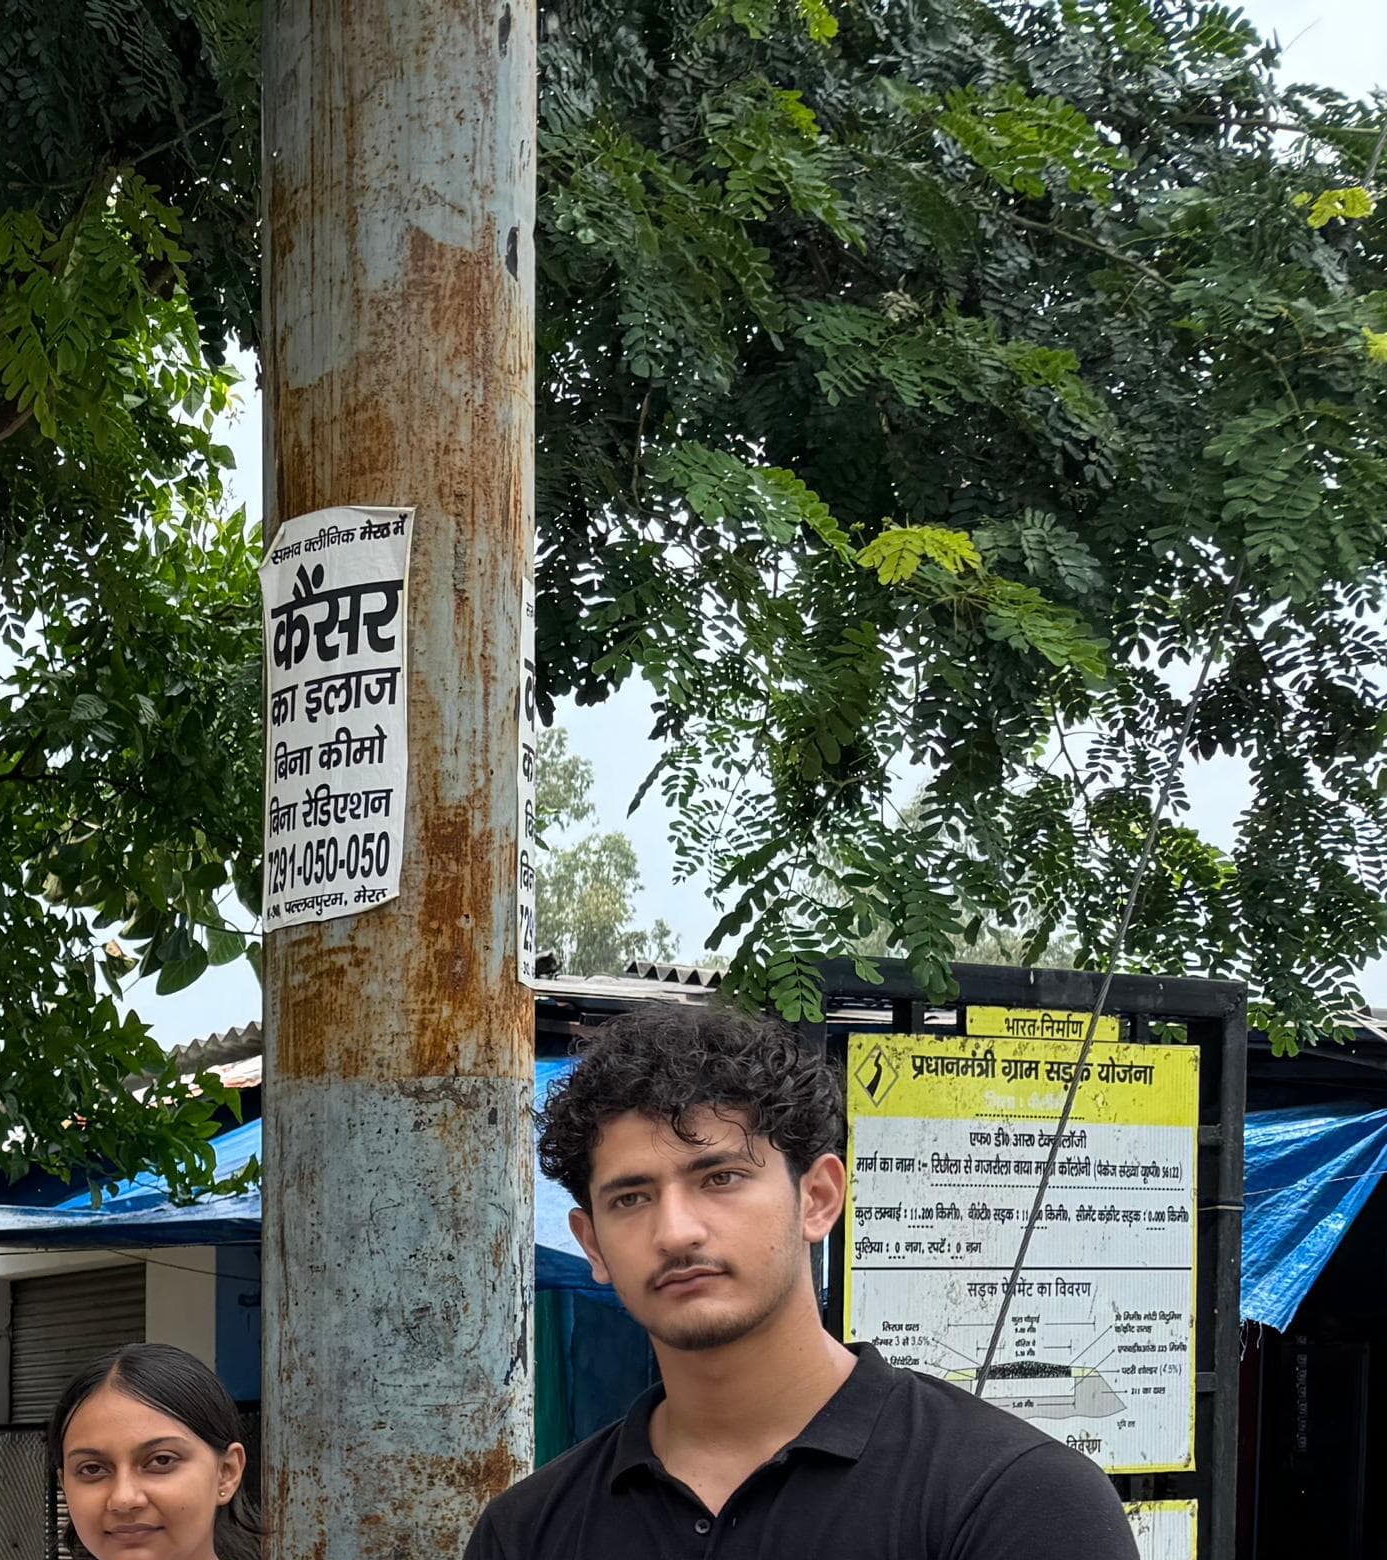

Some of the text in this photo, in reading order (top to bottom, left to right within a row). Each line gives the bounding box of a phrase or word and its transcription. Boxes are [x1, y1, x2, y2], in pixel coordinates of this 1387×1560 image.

[392, 513, 407, 536] में
[271, 562, 404, 672] कैंसर
[272, 666, 401, 727] का इलाज
[274, 723, 387, 785] बिना कीमो
[269, 783, 393, 838] बिना रेडिएशन
[268, 831, 390, 896] 7291-050-050
[911, 1049, 996, 1081] प्रधानमंत्री
[1001, 1059, 1040, 1084] ग्राम
[1097, 1056, 1155, 1086] योजना
[856, 1150, 878, 1173] मार्ग
[879, 1157, 893, 1173] का
[895, 1157, 915, 1173] नाम
[855, 1206, 873, 1226] कुल
[967, 1282, 998, 1300] सड़क
[1037, 1281, 1052, 1297] का
[1055, 1278, 1092, 1298] विवरण
